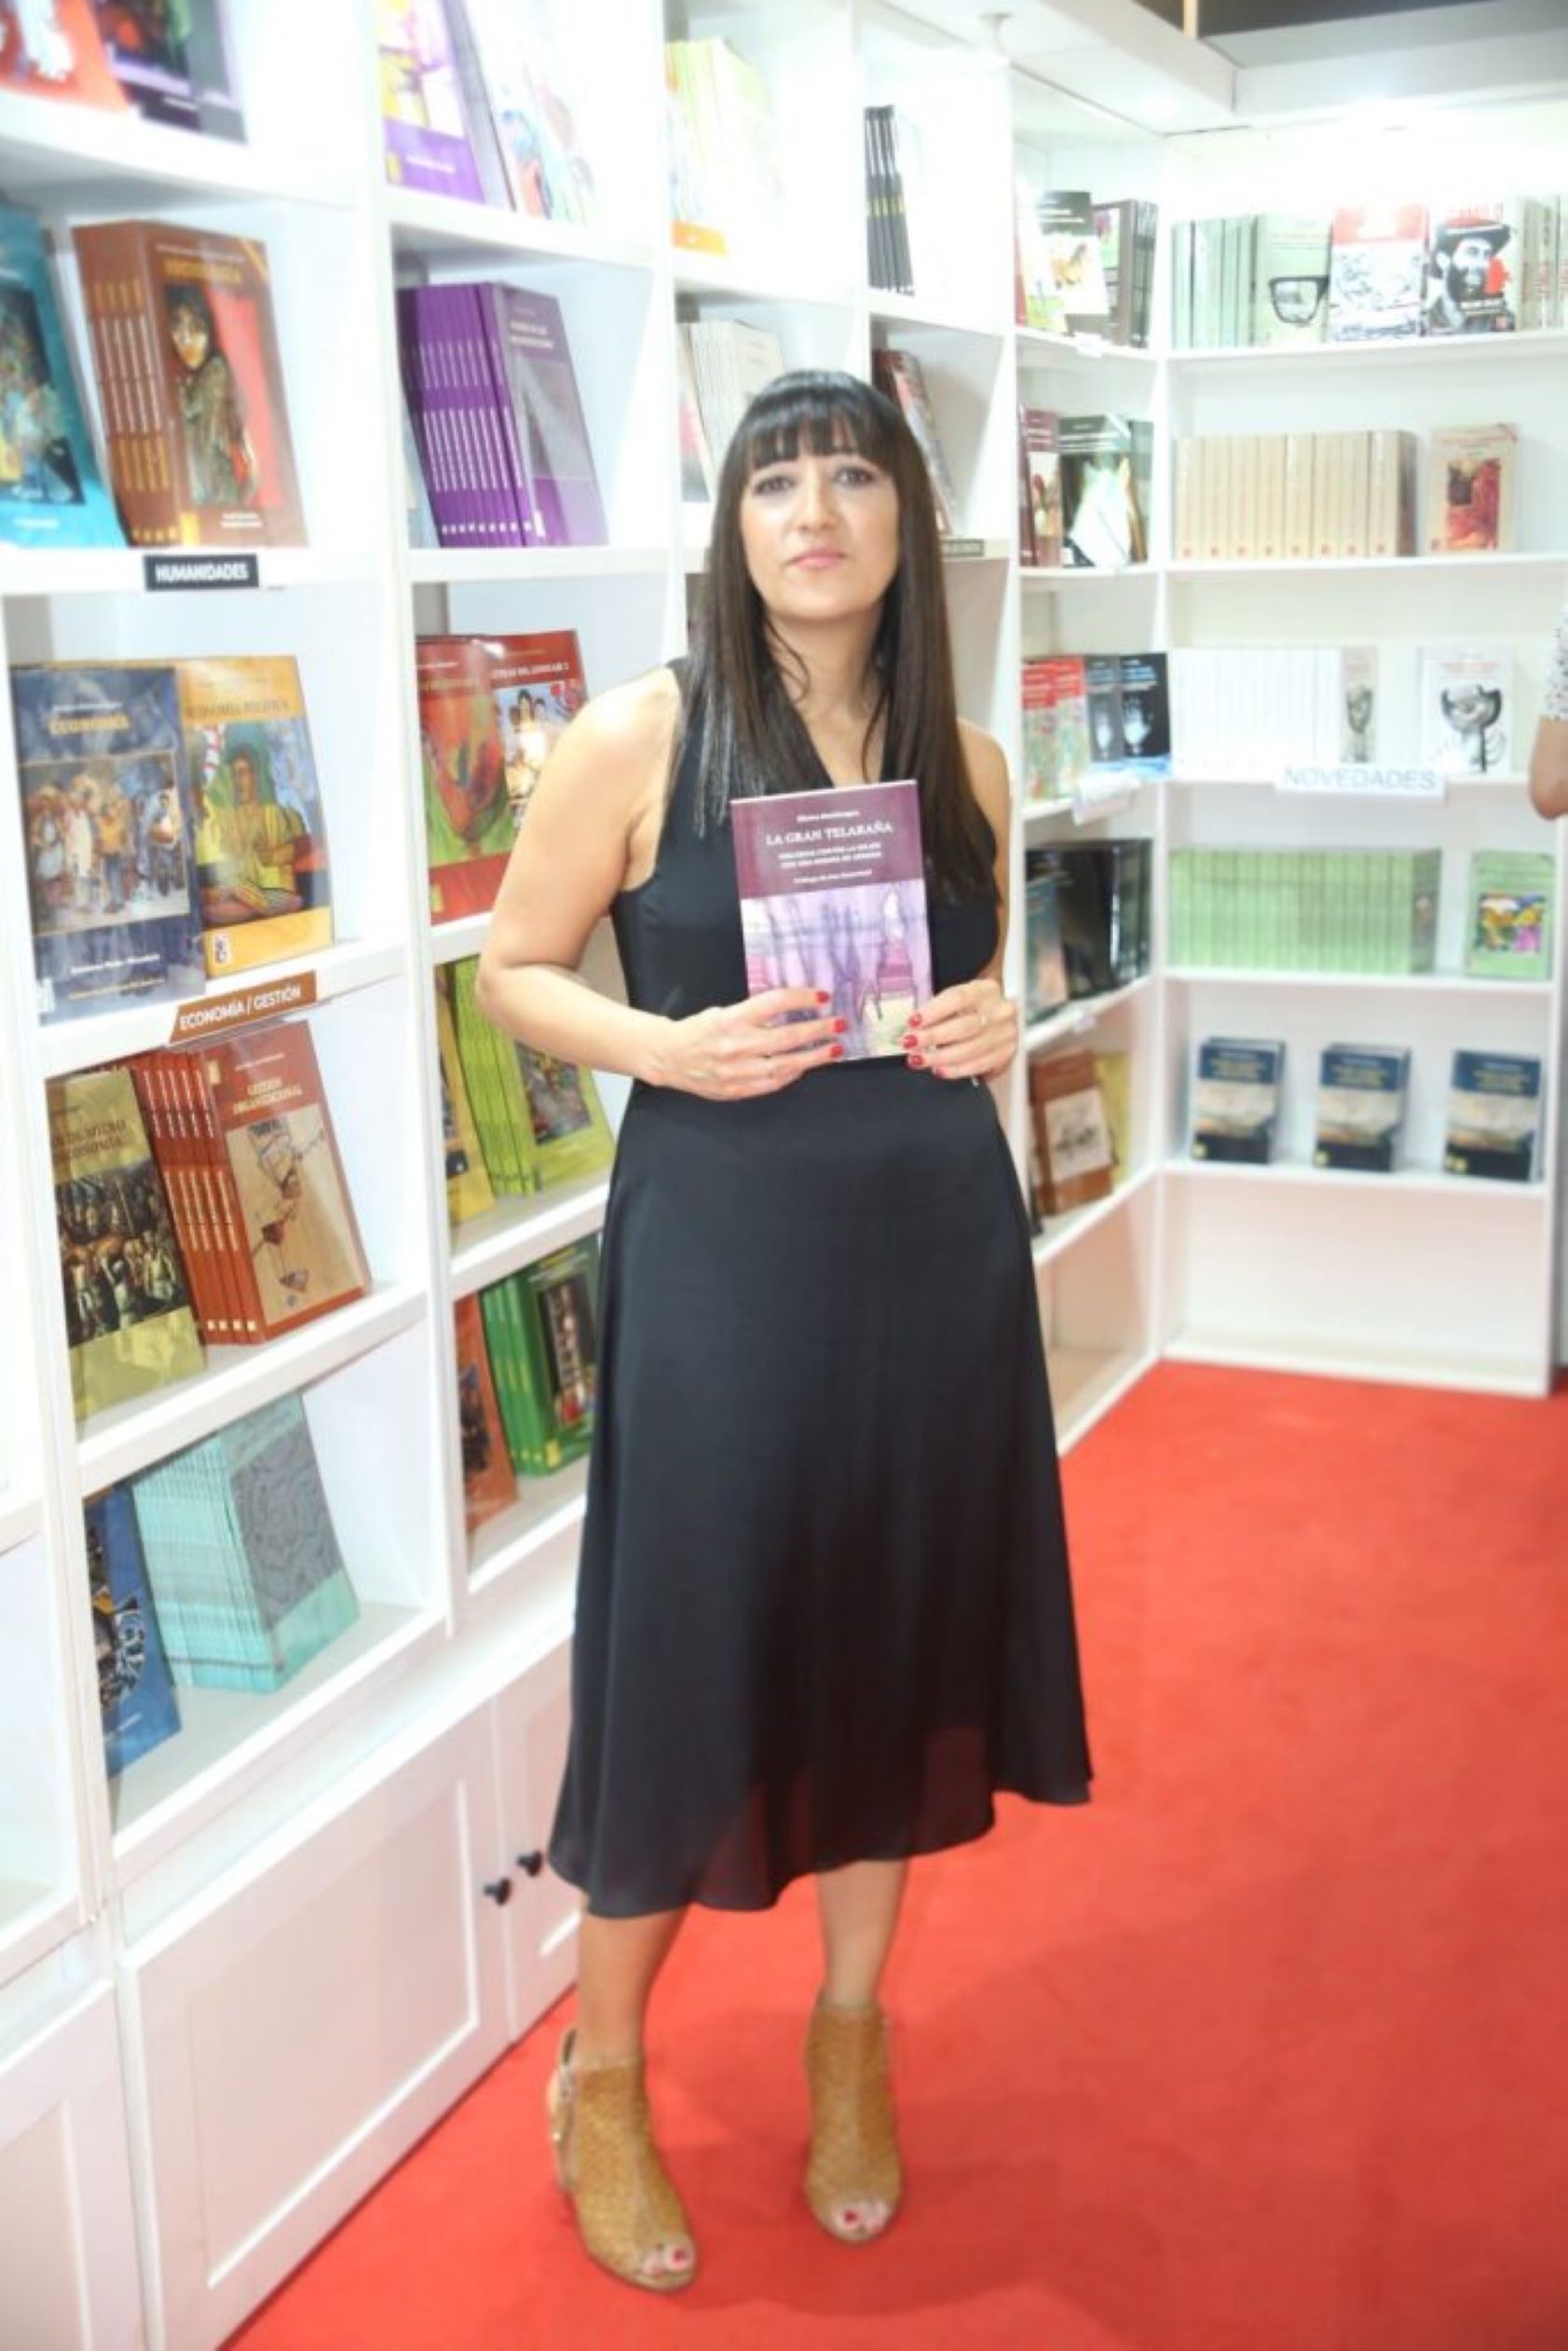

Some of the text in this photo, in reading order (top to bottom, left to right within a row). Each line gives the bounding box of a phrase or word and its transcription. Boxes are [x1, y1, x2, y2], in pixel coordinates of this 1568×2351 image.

[155, 562, 250, 582] HUMANIDADES
[1283, 766, 1437, 790] NOVEDADES
[766, 820, 893, 846] LA GRAN TELARAÑA
[180, 1000, 244, 1031] ECONOMÍA
[253, 983, 300, 1009] GESTIÓN
